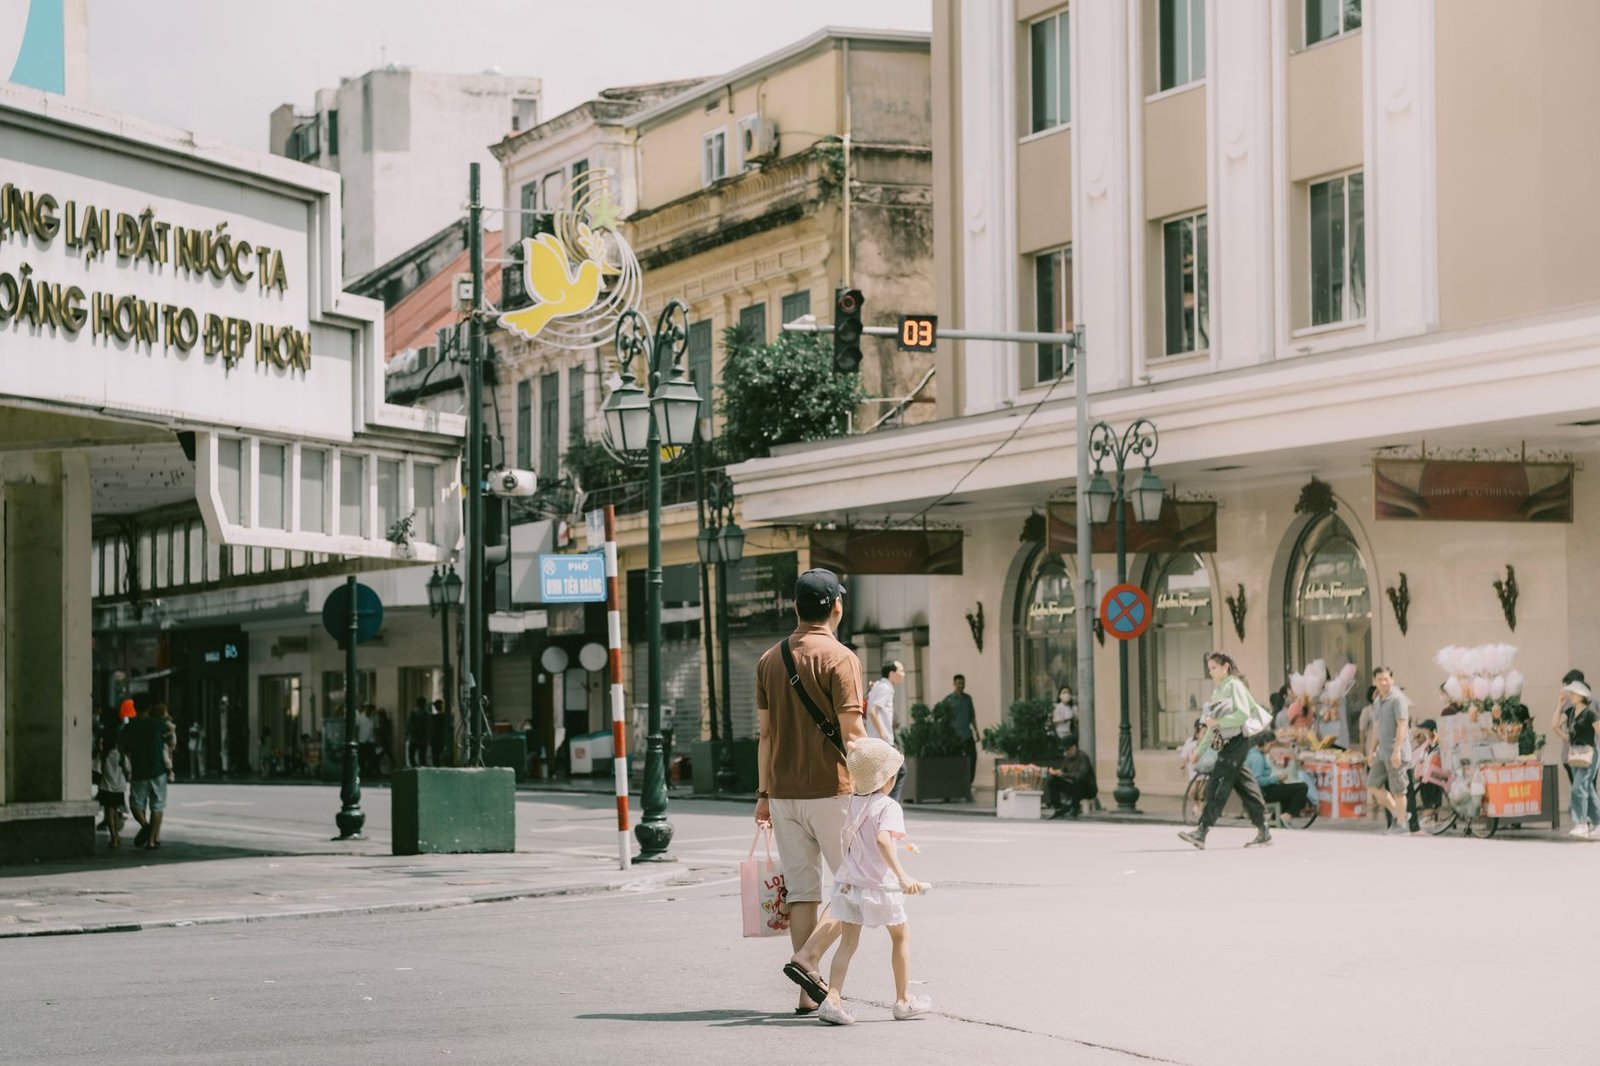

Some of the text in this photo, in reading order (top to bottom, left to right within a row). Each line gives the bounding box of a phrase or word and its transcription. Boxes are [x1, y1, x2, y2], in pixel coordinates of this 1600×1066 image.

[65, 200, 110, 260] LẠI
[115, 206, 171, 265] ĐẤT
[173, 221, 255, 284] NƯỚC
[256, 245, 289, 291] TA
[92, 291, 159, 343] HƠN
[161, 304, 198, 352] TO
[203, 313, 252, 369] ĐẸP
[255, 323, 311, 371] HƠN
[903, 320, 933, 346] 03
